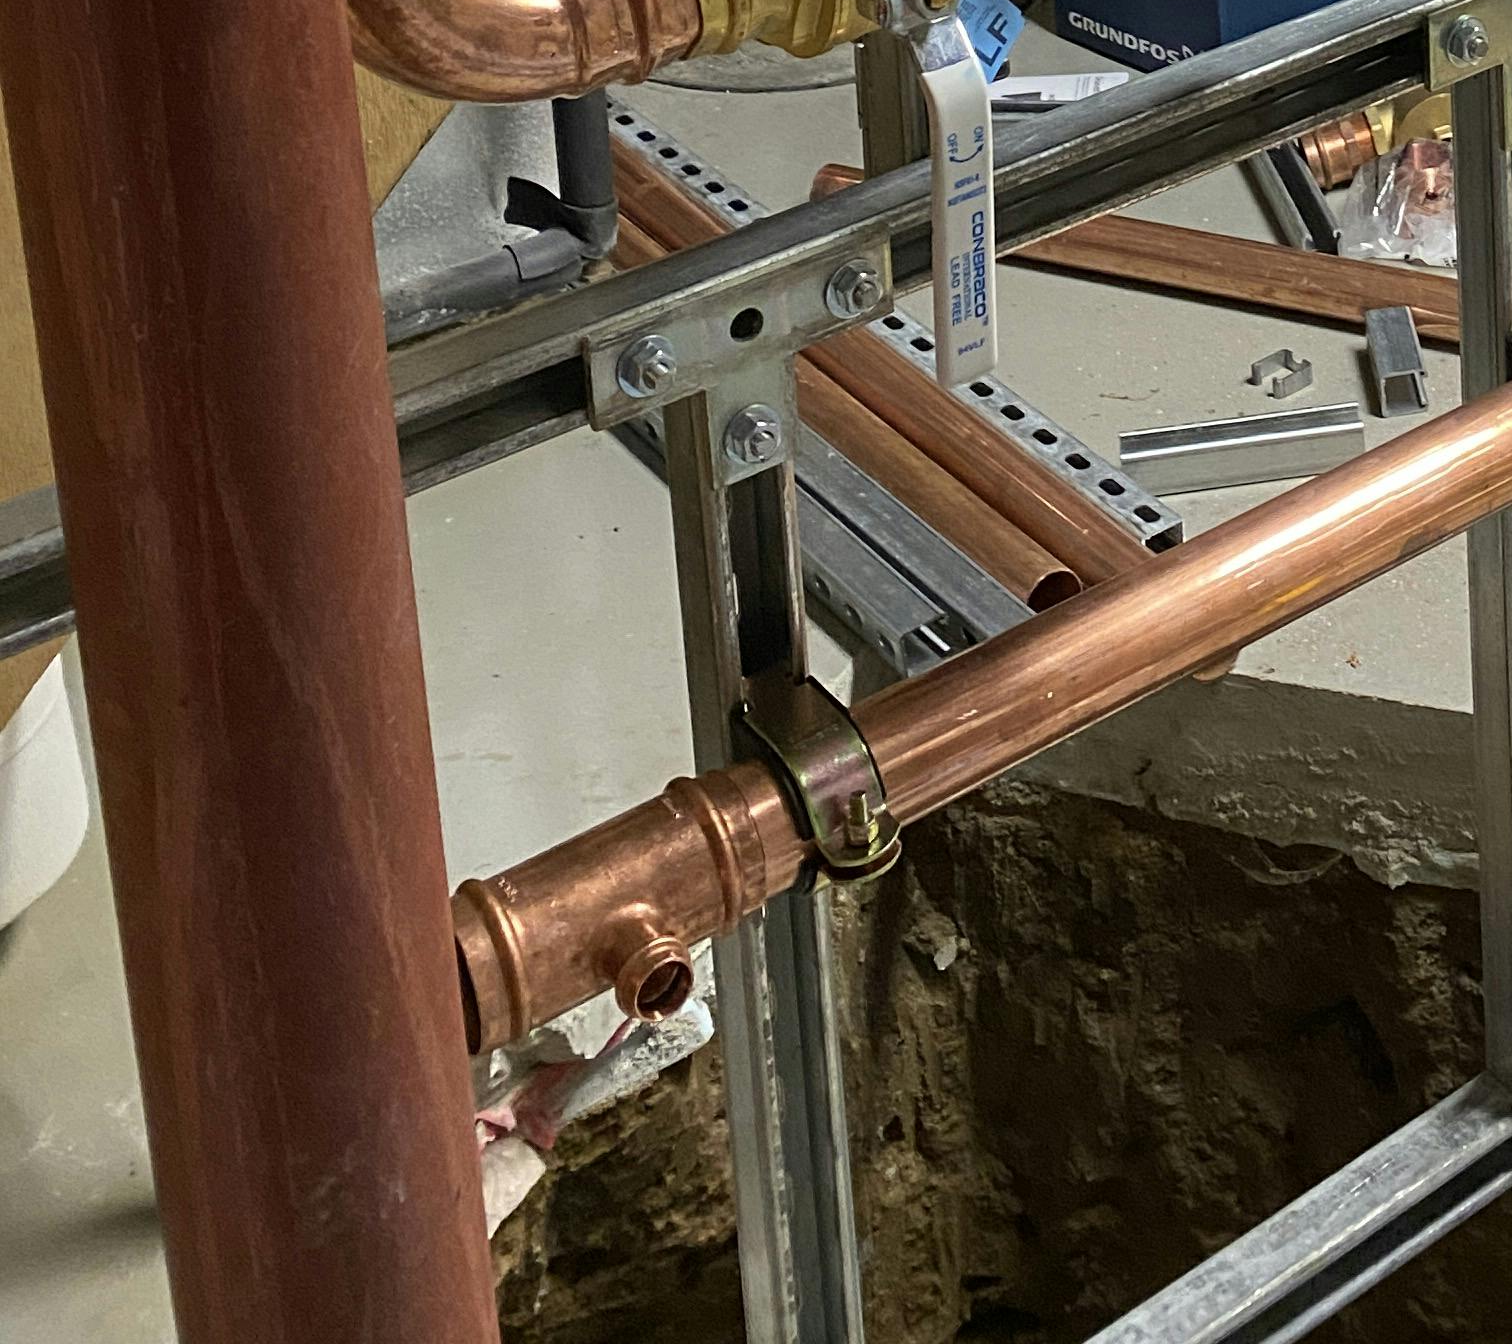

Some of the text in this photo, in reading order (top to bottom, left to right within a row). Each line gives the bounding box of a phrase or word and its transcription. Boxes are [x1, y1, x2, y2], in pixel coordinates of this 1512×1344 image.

[975, 11, 1010, 68] LF
[1067, 11, 1182, 66] GRUNDFOS
[946, 132, 959, 155] OFF
[973, 125, 985, 144] ON
[949, 257, 962, 326] LEAD FREE
